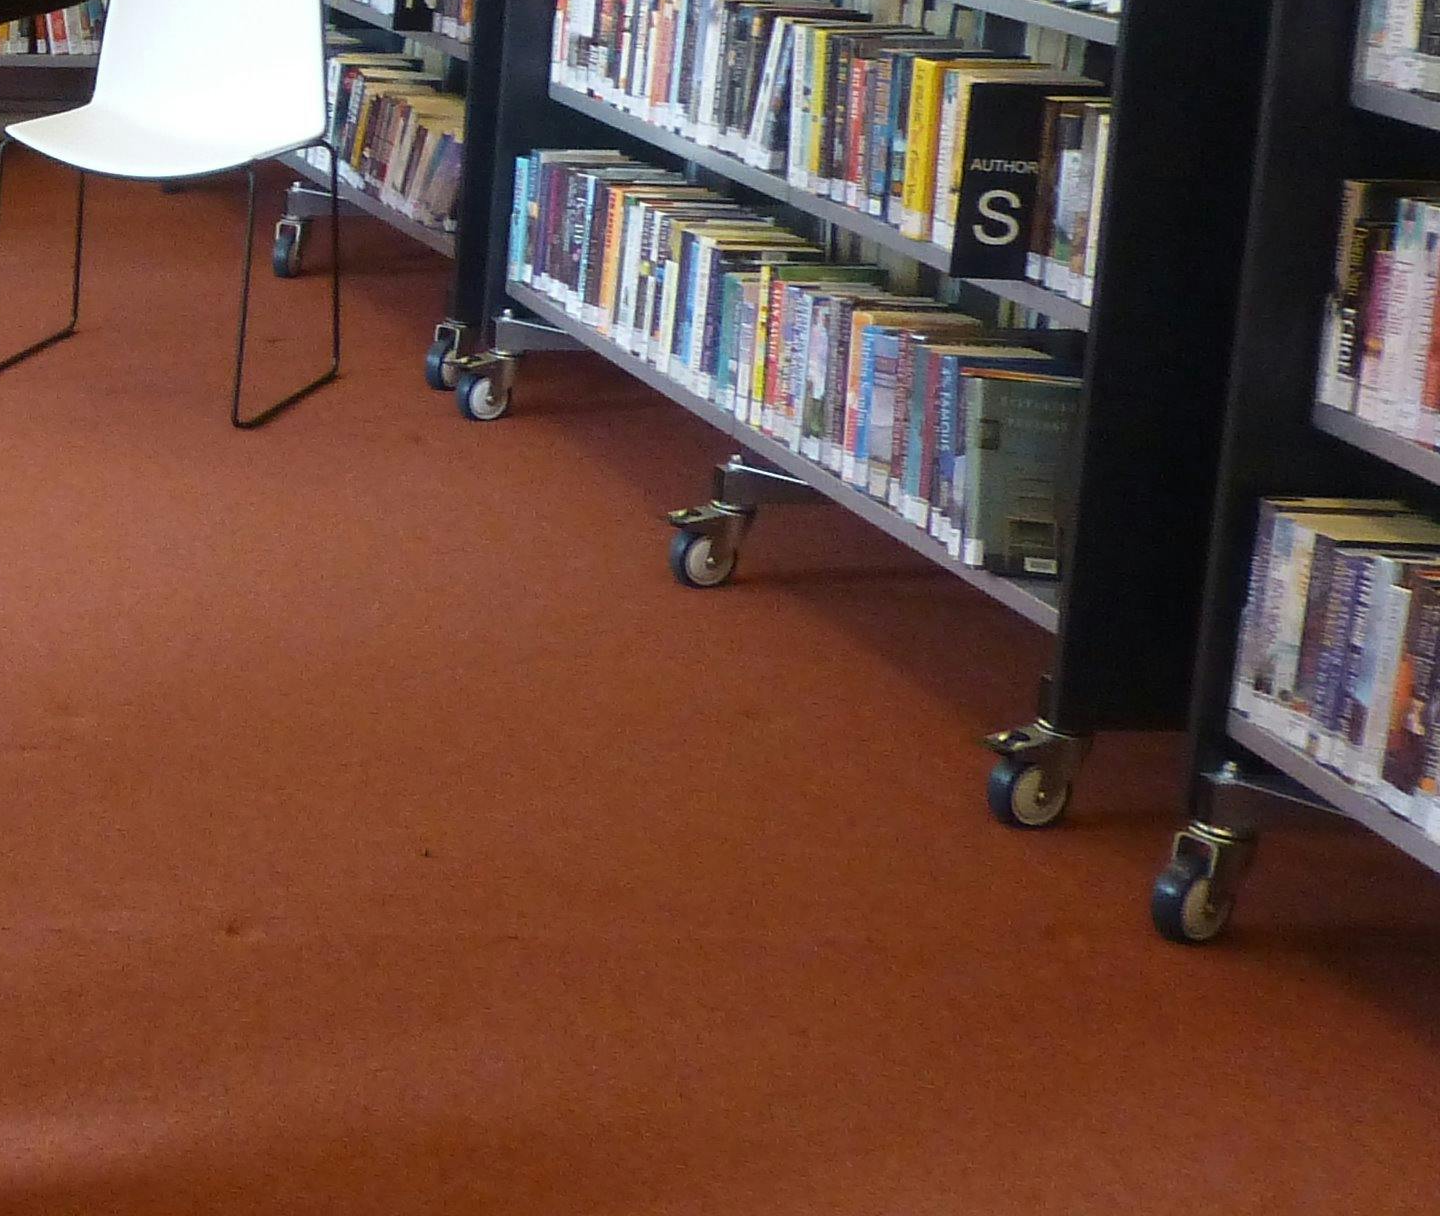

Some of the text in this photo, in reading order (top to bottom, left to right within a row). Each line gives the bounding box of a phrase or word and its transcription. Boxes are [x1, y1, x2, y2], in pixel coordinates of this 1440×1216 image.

[970, 158, 1040, 174] AUTHOR
[972, 189, 1021, 245] S
[939, 391, 952, 452] FAMOUS
